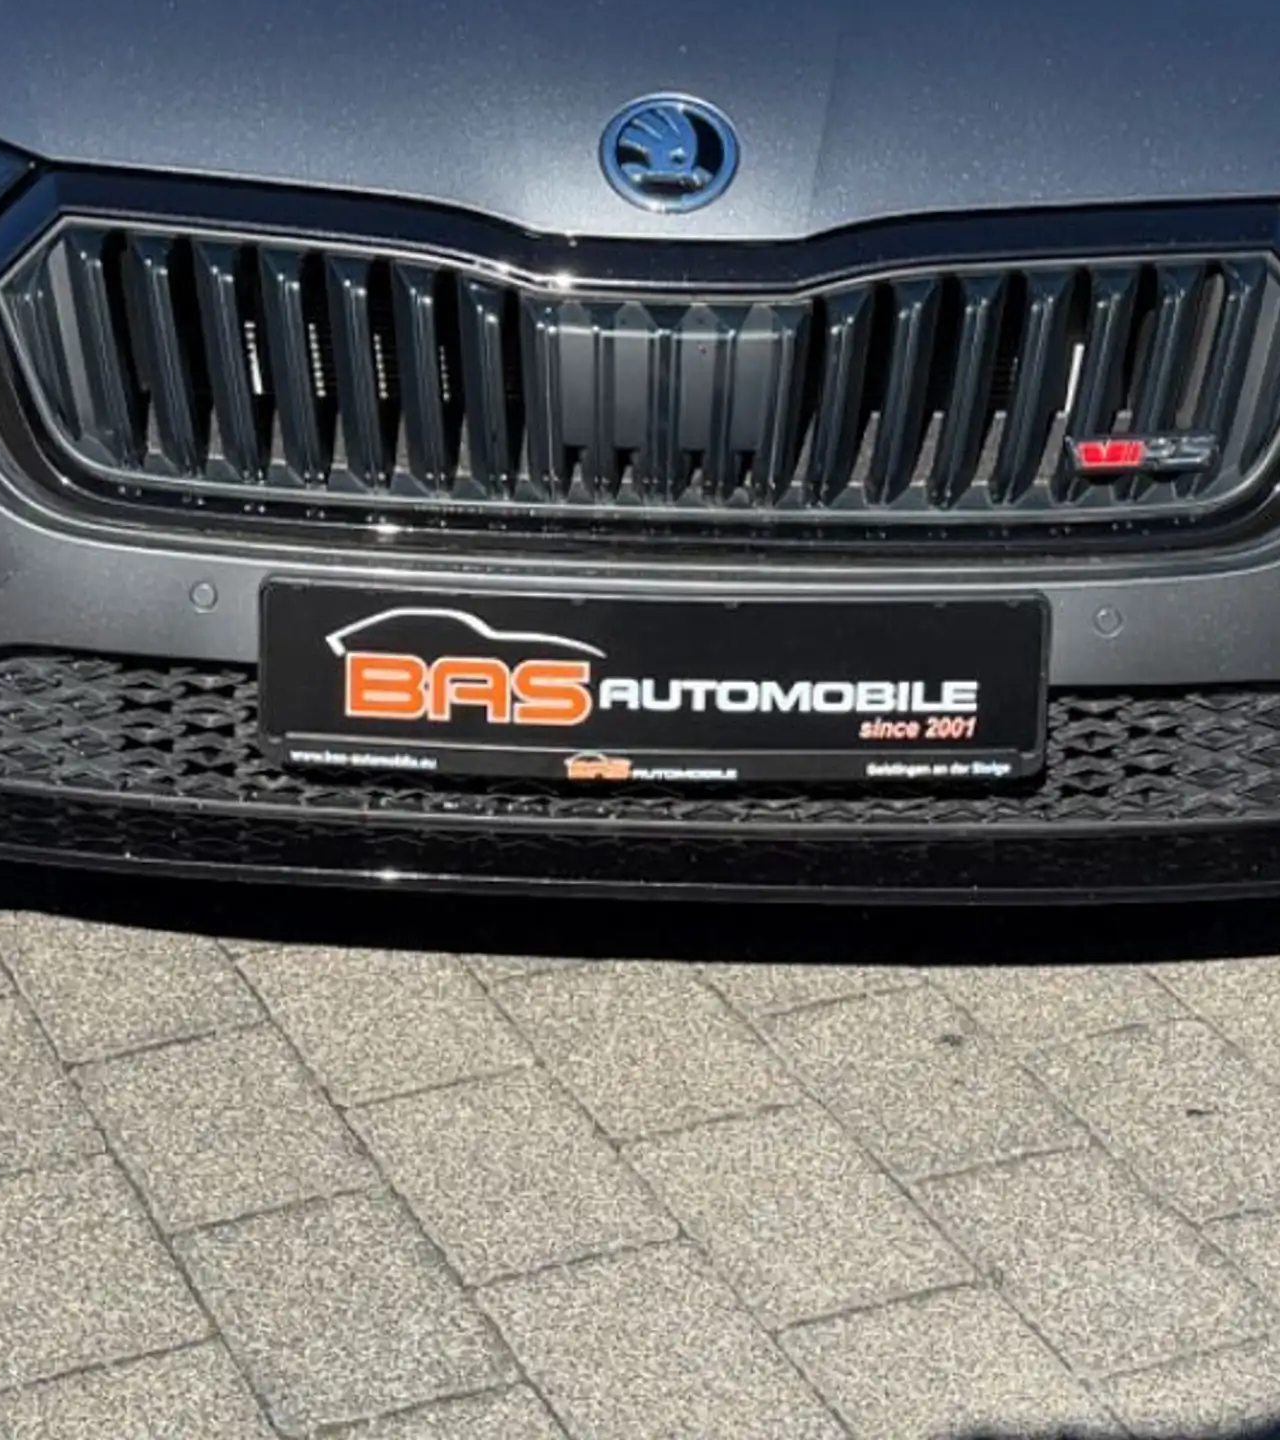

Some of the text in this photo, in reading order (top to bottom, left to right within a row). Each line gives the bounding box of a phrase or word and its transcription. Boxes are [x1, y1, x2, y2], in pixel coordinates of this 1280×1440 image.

[346, 652, 978, 726] BAS AUTOMOBILE
[859, 715, 977, 739] since 2001
